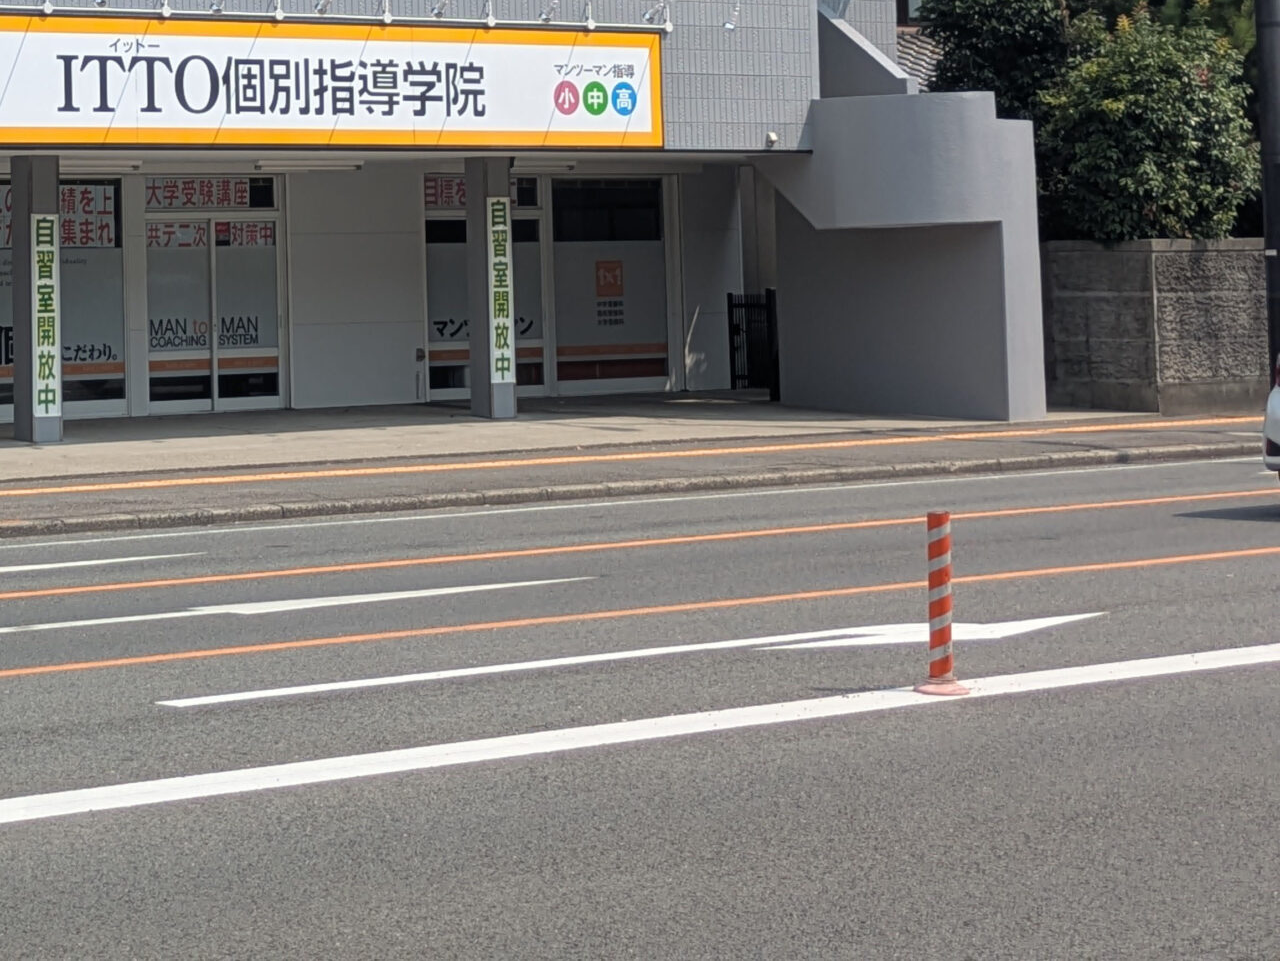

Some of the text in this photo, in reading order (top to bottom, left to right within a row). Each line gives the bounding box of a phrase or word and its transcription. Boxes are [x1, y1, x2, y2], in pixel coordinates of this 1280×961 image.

[108, 38, 160, 54] イットー
[553, 63, 636, 79] マンツーマン指導
[558, 87, 633, 110] 小 中 高
[146, 178, 249, 207] 大学受験講座
[490, 199, 511, 381] 自習室開放中
[35, 217, 56, 415] 自習室開放中
[149, 316, 258, 337] MAN to MAN
[149, 333, 259, 349] COACHING SYSTEM
